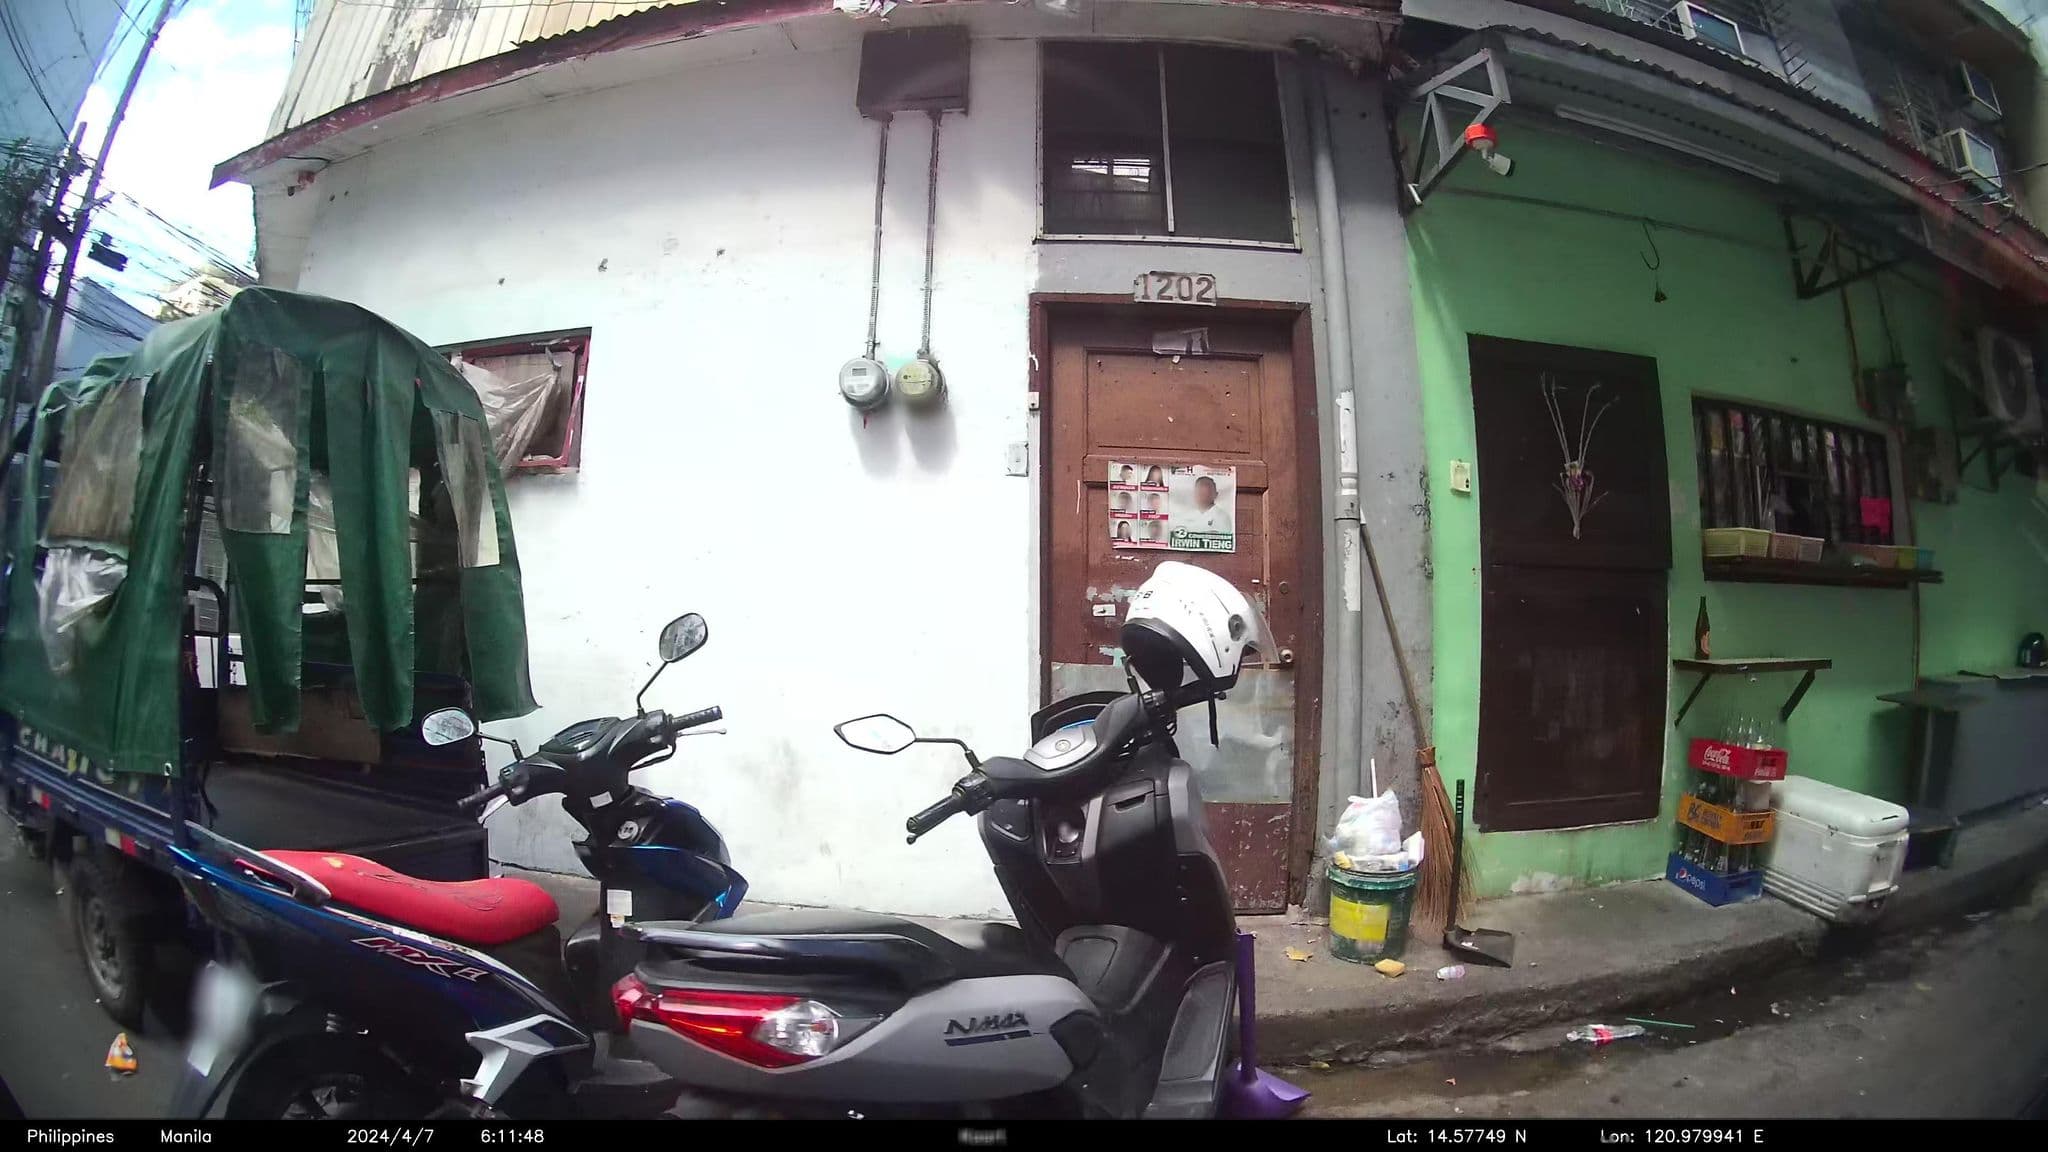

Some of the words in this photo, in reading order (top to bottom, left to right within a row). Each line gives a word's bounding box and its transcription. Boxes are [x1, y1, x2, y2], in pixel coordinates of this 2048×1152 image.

[1141, 273, 1214, 303] 1202
[1171, 537, 1201, 549] IRWIN
[1202, 538, 1232, 550] TIENG
